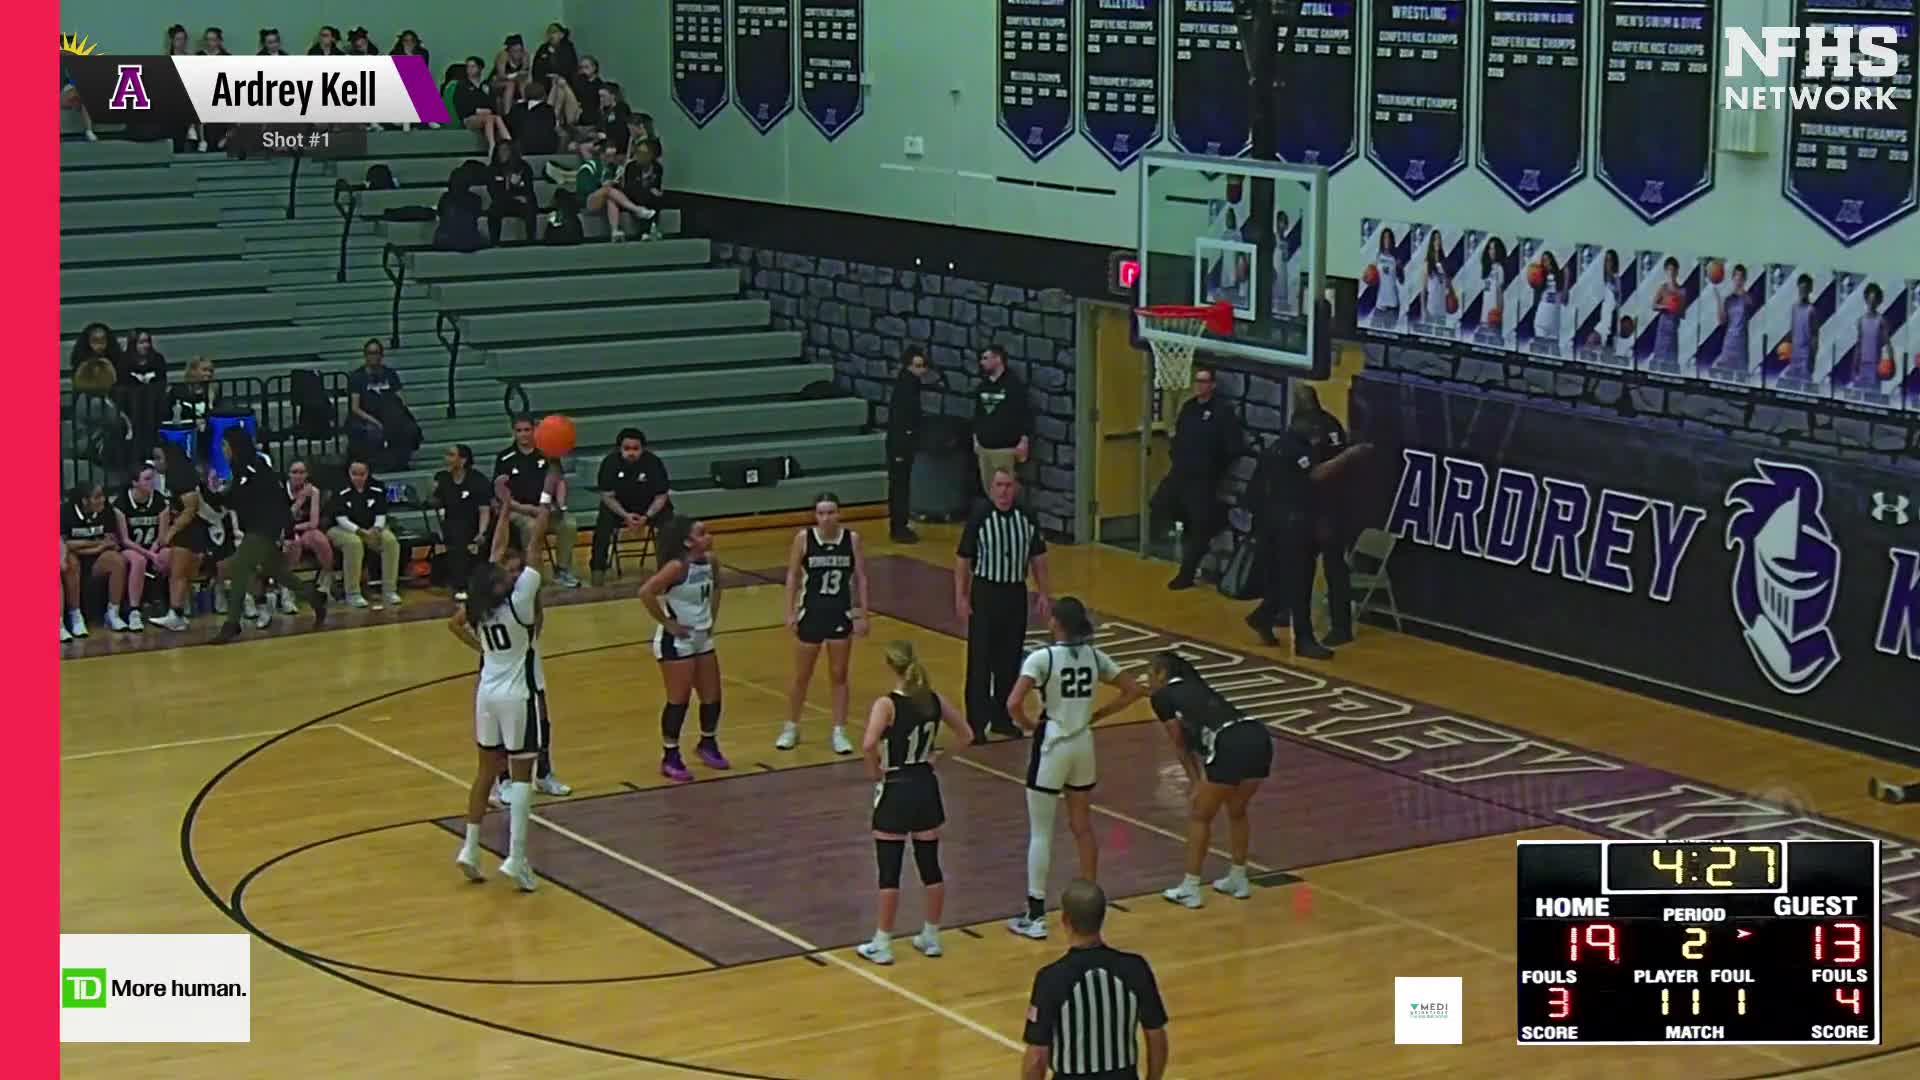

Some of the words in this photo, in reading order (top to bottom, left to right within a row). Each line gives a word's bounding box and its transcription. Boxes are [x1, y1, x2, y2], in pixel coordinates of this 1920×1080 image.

[1392, 5, 1447, 20] WRESTLING
[1615, 14, 1644, 28] MEN'S
[1612, 40, 1666, 54] CONFERENCE
[1668, 42, 1704, 56] CHAMPS
[1800, 123, 1865, 139] TOURNAMENT
[1866, 128, 1907, 142] CHAMPS
[1388, 449, 1706, 602] ARDREY
[819, 569, 842, 595] 13
[482, 623, 512, 651] 10
[1061, 667, 1092, 698] 22
